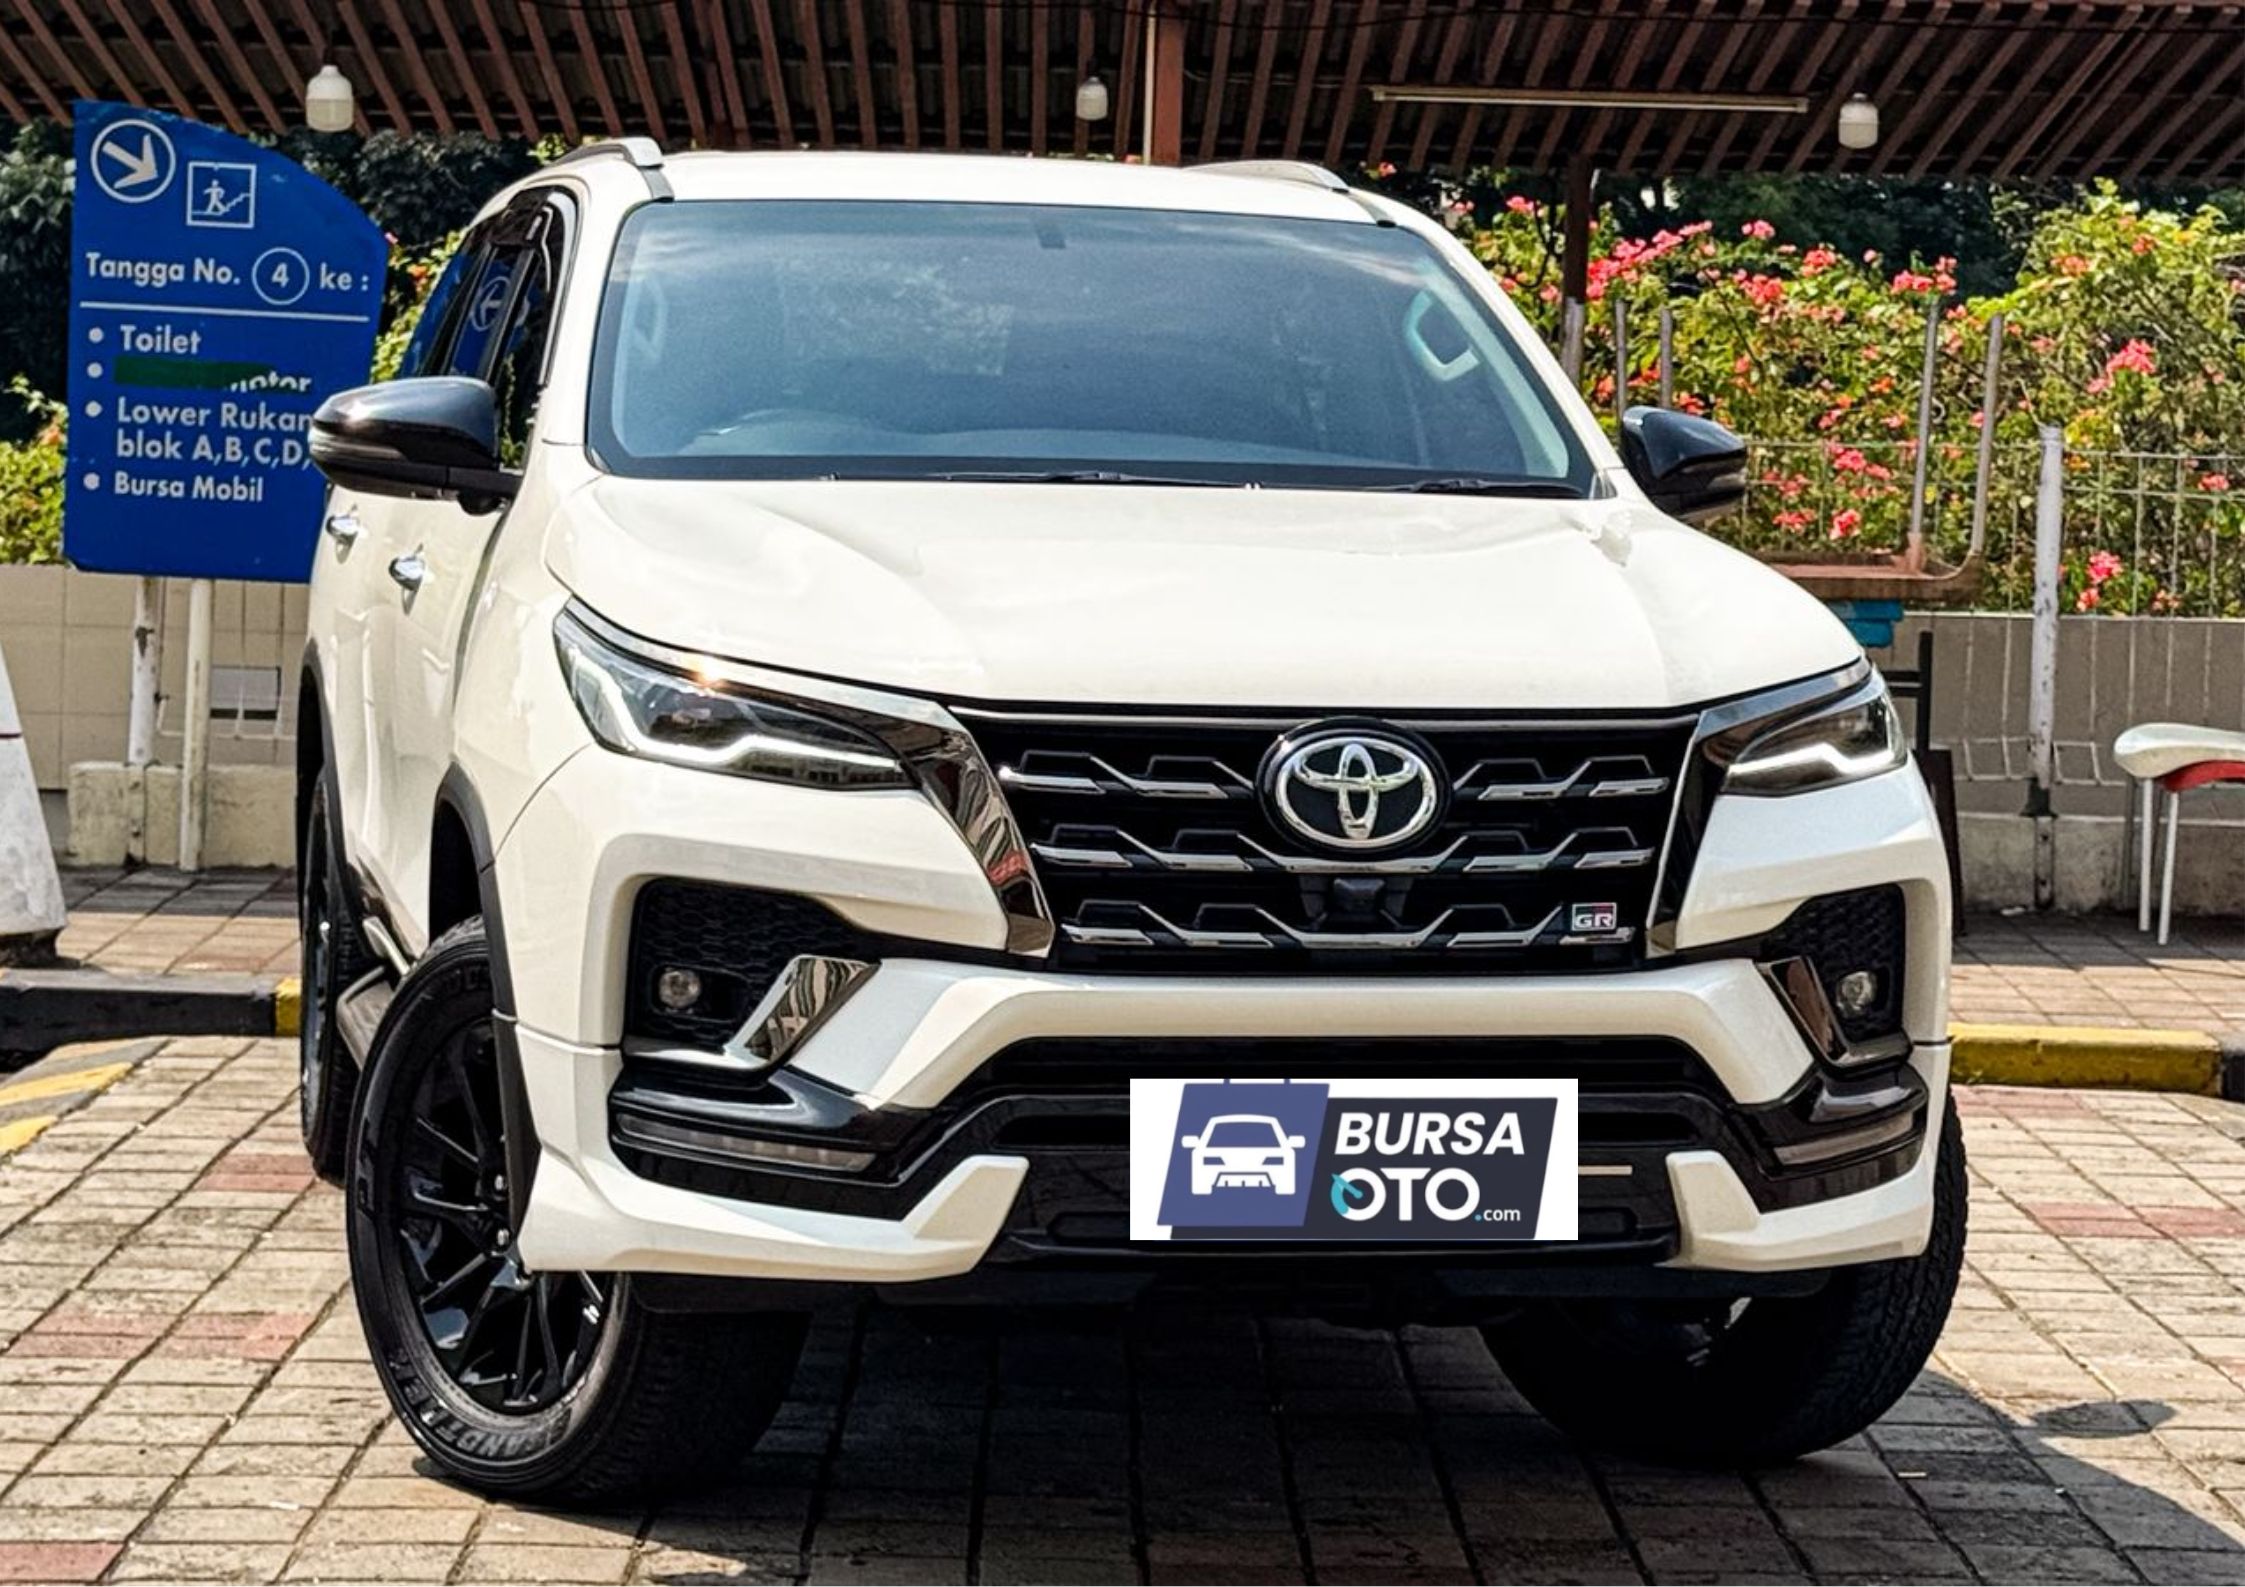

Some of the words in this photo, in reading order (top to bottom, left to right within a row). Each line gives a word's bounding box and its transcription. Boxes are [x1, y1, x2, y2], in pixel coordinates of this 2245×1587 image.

[86, 252, 185, 288] Tangga
[193, 258, 240, 285] No.
[272, 263, 289, 287] 4
[120, 324, 202, 354] Toilet
[118, 396, 211, 426] Lower
[221, 402, 313, 432] Rukan
[116, 428, 183, 459] blok
[114, 471, 185, 498] Bursa
[191, 475, 263, 502] Mobil
[1575, 913, 1613, 929] GR
